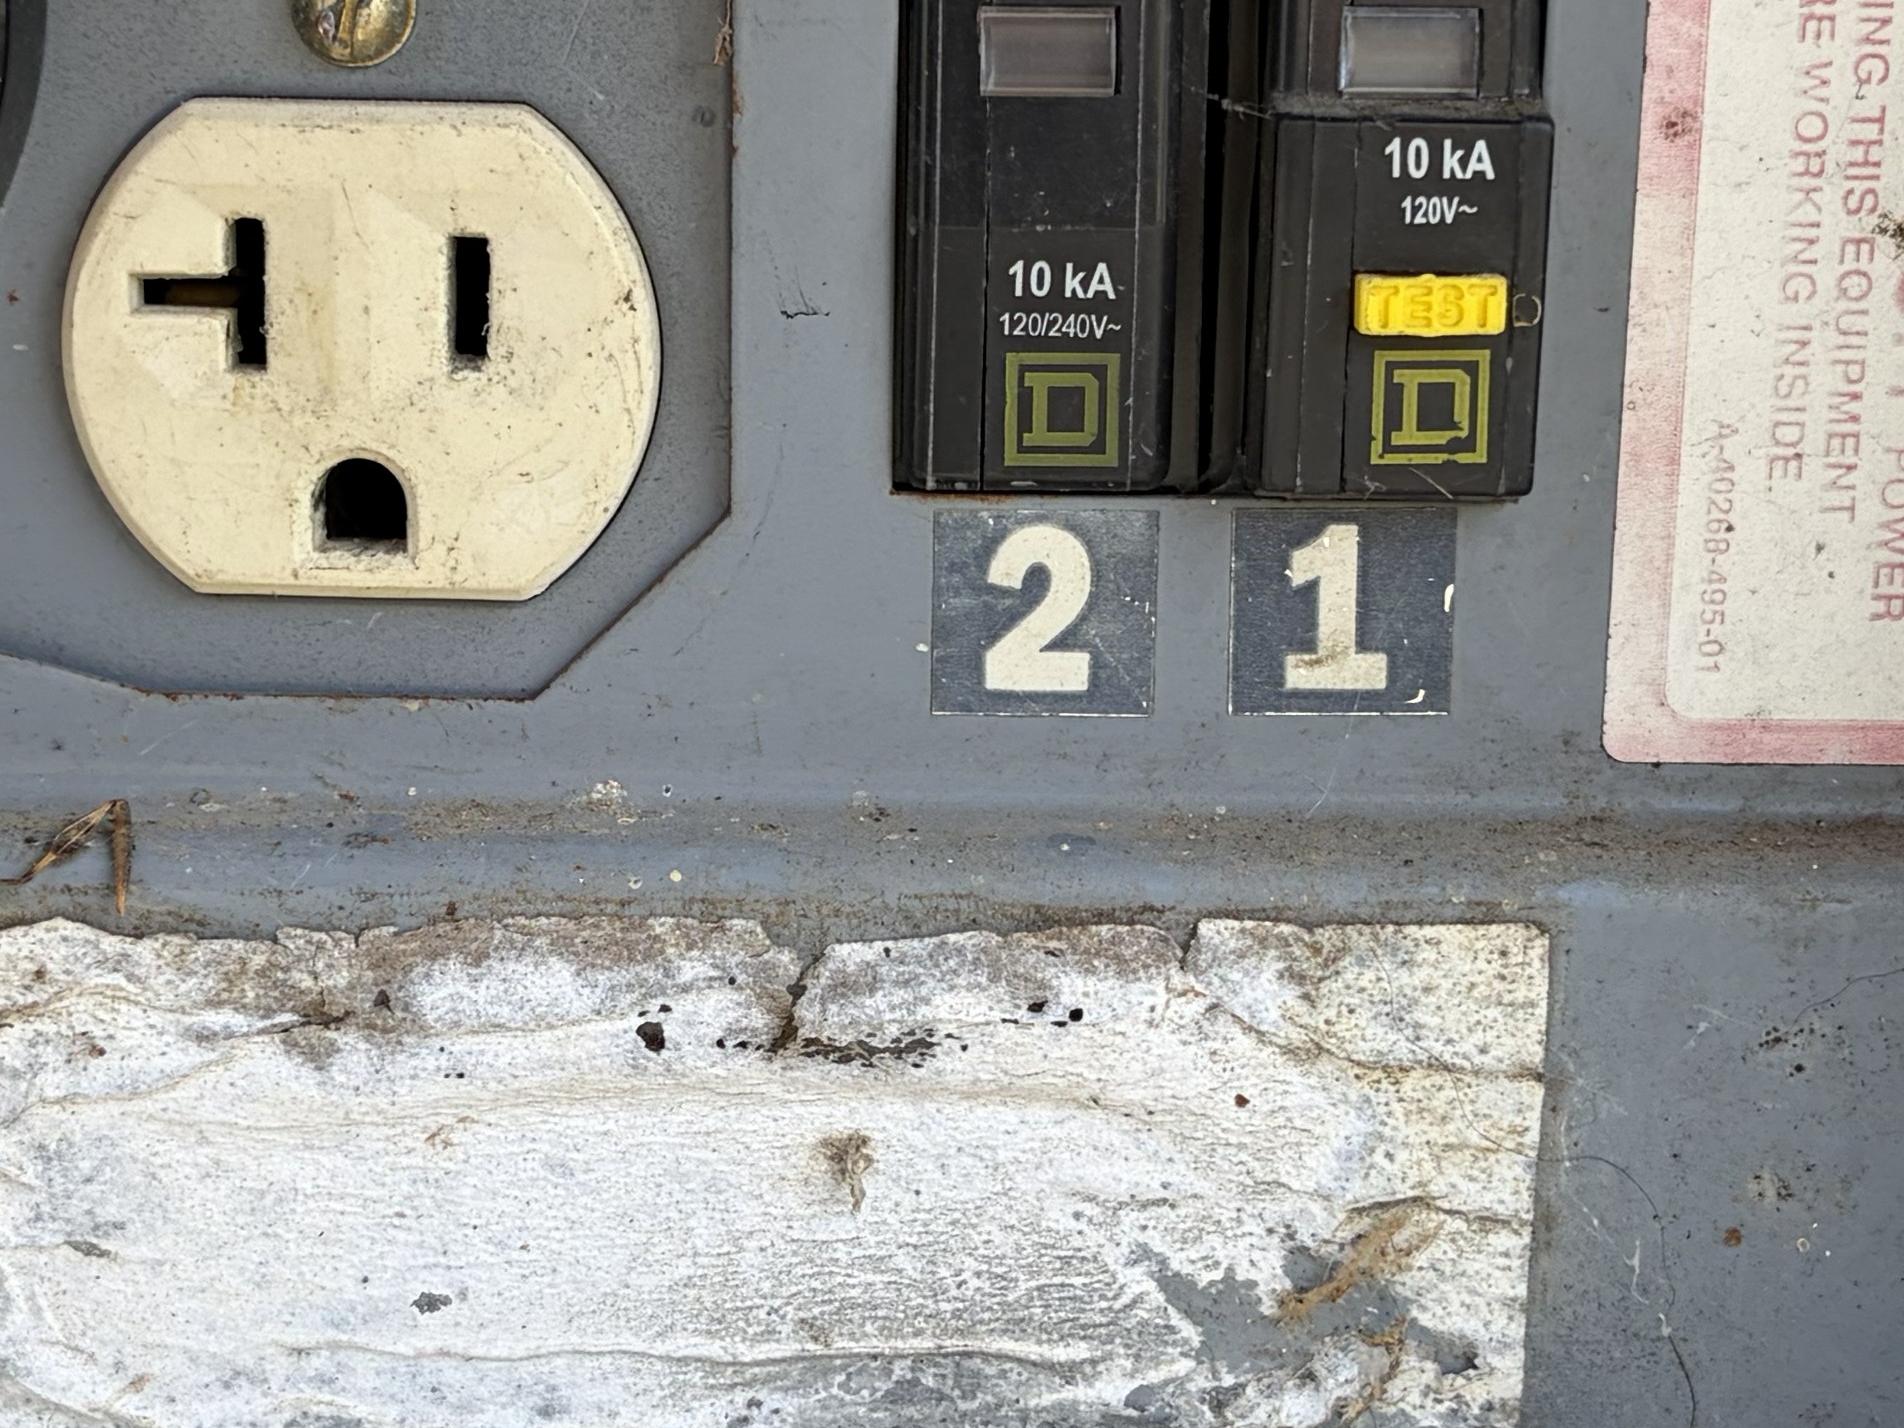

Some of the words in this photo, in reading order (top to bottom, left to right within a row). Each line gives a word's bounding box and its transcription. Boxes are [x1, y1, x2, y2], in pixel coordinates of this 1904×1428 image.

[1384, 136, 1429, 179] 10
[1442, 138, 1496, 181] kA
[1779, 59, 1833, 304] WORKING
[1841, 105, 1887, 218] THIS
[1007, 259, 1052, 298] 10
[1064, 261, 1117, 300] kA
[1370, 283, 1497, 329] TEST
[1819, 236, 1876, 523] EQUIPMENT
[984, 523, 1091, 692] 2
[1285, 523, 1388, 691] 1
